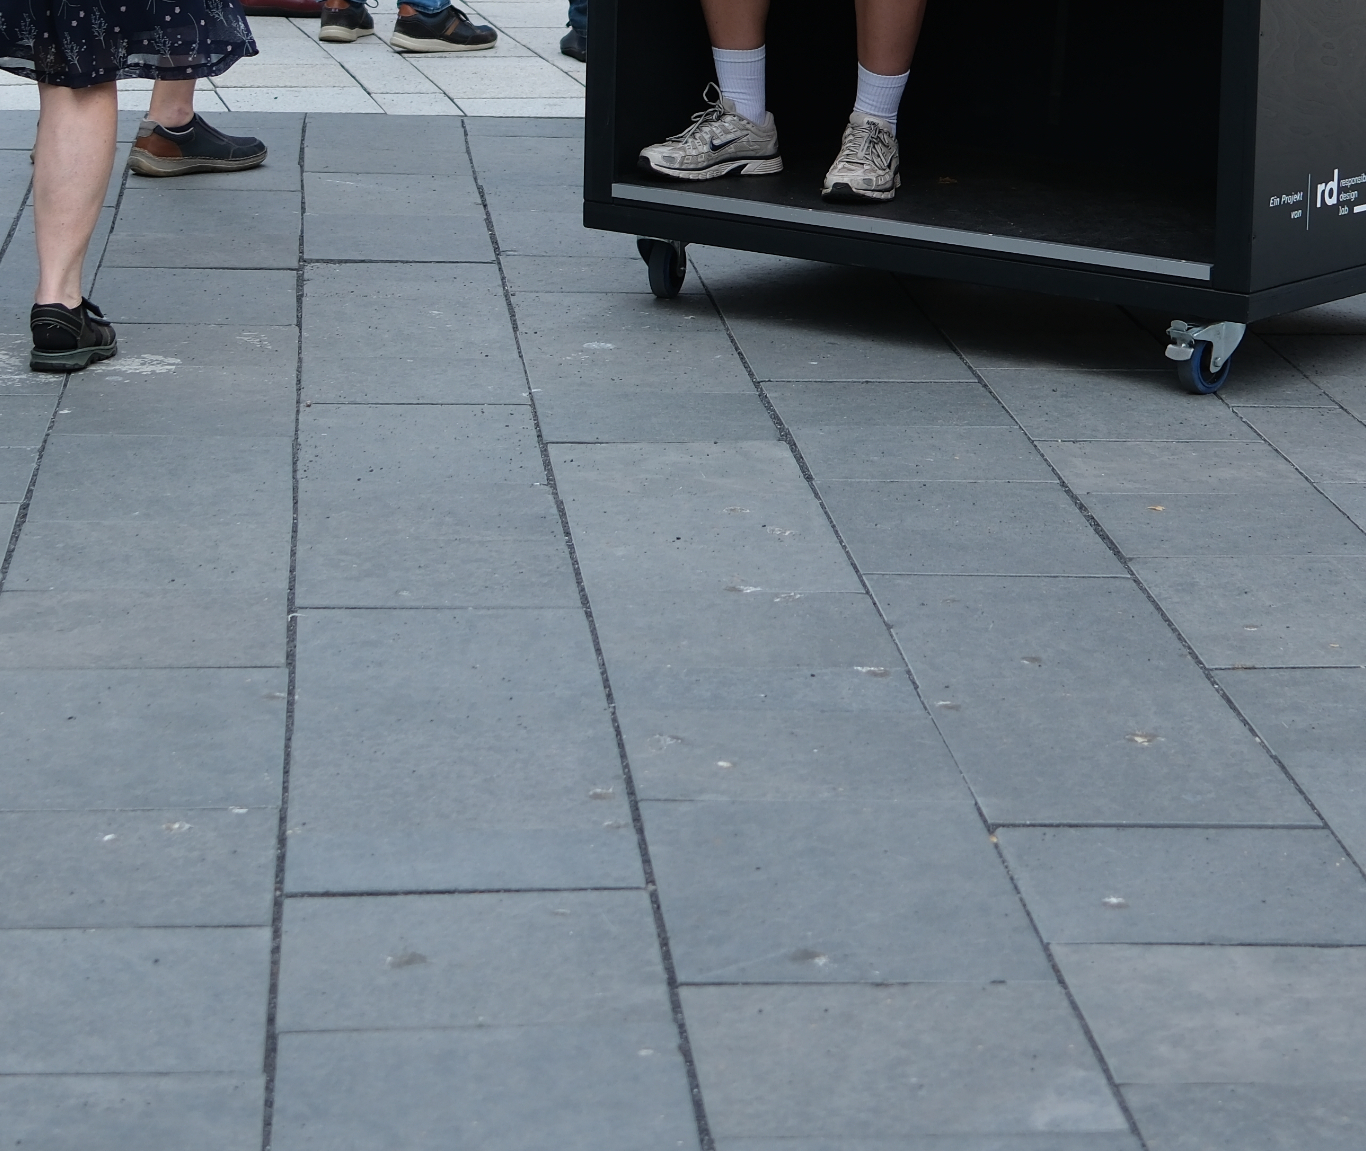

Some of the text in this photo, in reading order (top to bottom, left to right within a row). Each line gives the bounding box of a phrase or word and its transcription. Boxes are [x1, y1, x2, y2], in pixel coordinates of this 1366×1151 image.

[1316, 168, 1339, 208] rd
[1269, 191, 1304, 207] Ein Projekt
[1339, 190, 1358, 202] design
[1290, 209, 1303, 219] von
[1338, 205, 1349, 216] lab
